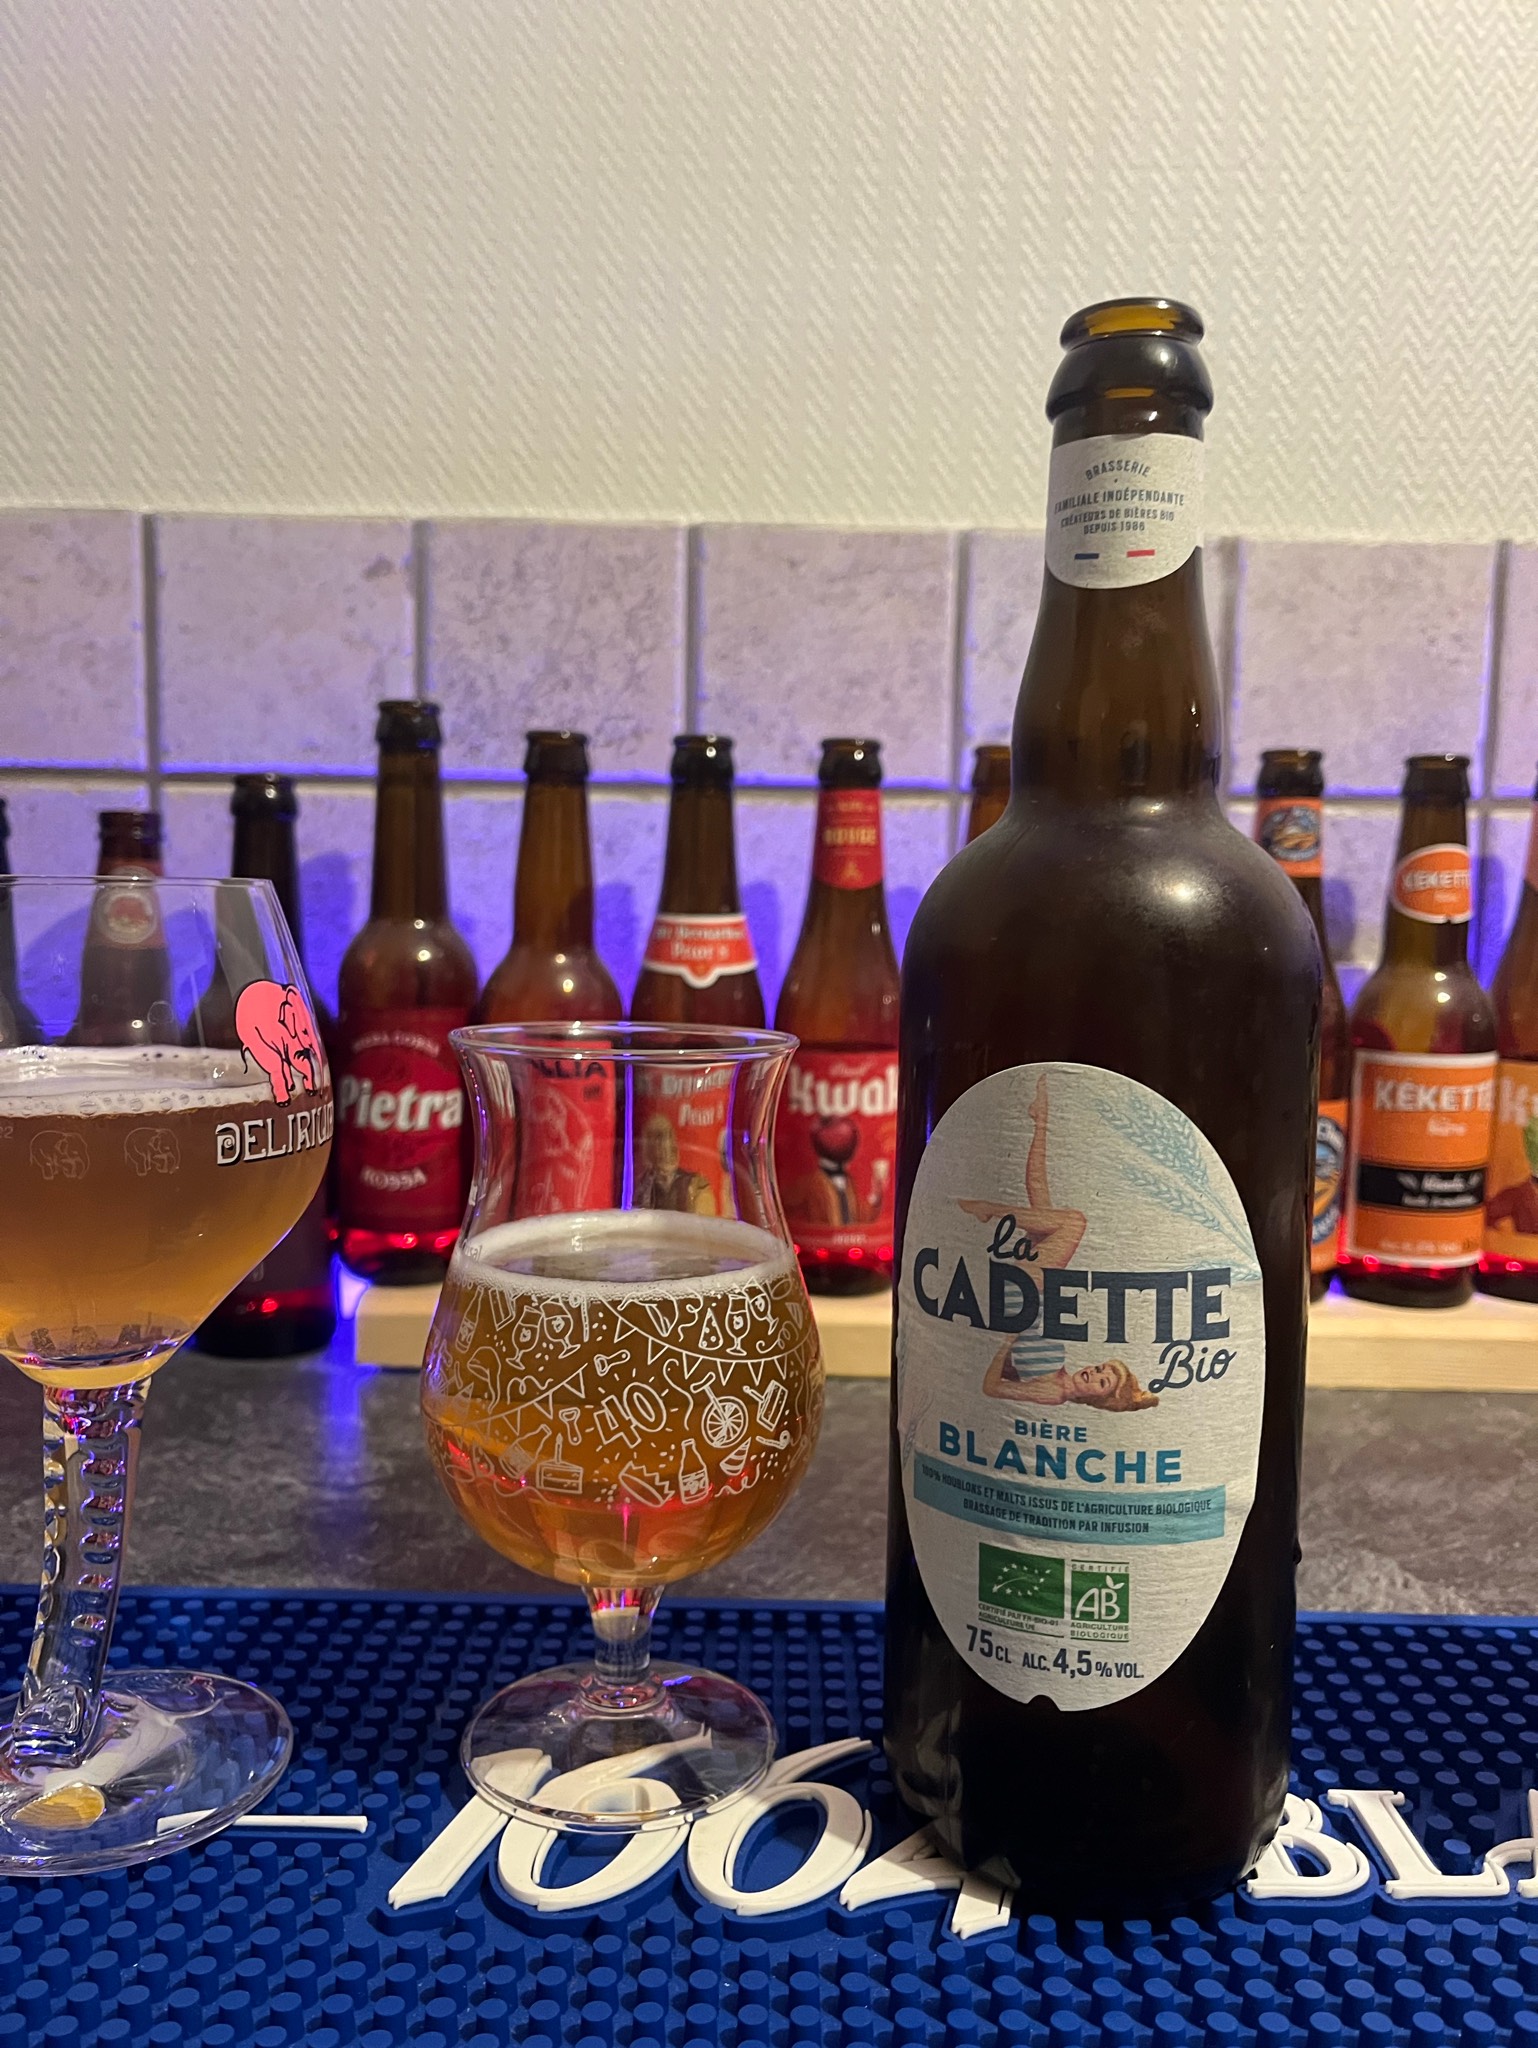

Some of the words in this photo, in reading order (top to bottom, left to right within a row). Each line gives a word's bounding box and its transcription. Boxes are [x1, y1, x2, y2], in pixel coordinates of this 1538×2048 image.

[1085, 459, 1151, 481] BRASSERIE
[1054, 491, 1099, 515] FAMILIALE
[1102, 487, 1185, 506] INDÉPENDANTE
[1060, 510, 1106, 529] CRÉATEURS
[1109, 508, 1121, 519] DE
[1124, 506, 1157, 520] BIÈRES
[1159, 510, 1174, 521] BIO
[1083, 521, 1117, 535] DEPUIS
[1120, 520, 1146, 532] 1986
[337, 1074, 464, 1131] Pietra
[987, 1214, 1039, 1261] la
[913, 1247, 1231, 1343] CADETTE
[1148, 1340, 1237, 1393] Bio
[1015, 1418, 1087, 1443] BIÈRE
[939, 1421, 1182, 1484] BLANCHE
[922, 1463, 941, 1482] 100%
[942, 1473, 982, 1496] HOUBLONS
[984, 1487, 994, 1499] ET
[996, 1491, 1026, 1506] MALTS
[1028, 1496, 1058, 1511] ISSUS
[1061, 1501, 1074, 1512] DE
[1076, 1502, 1153, 1515] L'AGRICULTURE
[1155, 1499, 1212, 1515] BIOLOGIQUE
[963, 1498, 1007, 1520] BRASSAGE
[1009, 1512, 1021, 1523] DE
[1023, 1513, 1076, 1531] TRADITION
[1078, 1521, 1098, 1532] PAR
[1100, 1521, 1149, 1533] INFUSION
[1075, 1587, 1121, 1620] AB
[1070, 1622, 1129, 1632] AGRICULTURE
[1070, 1631, 1129, 1640] BIOLOGIQUE
[1022, 1652, 1050, 1672] ALC.
[1116, 1662, 1145, 1678] VOL.
[1247, 1788, 1538, 1899] BL
